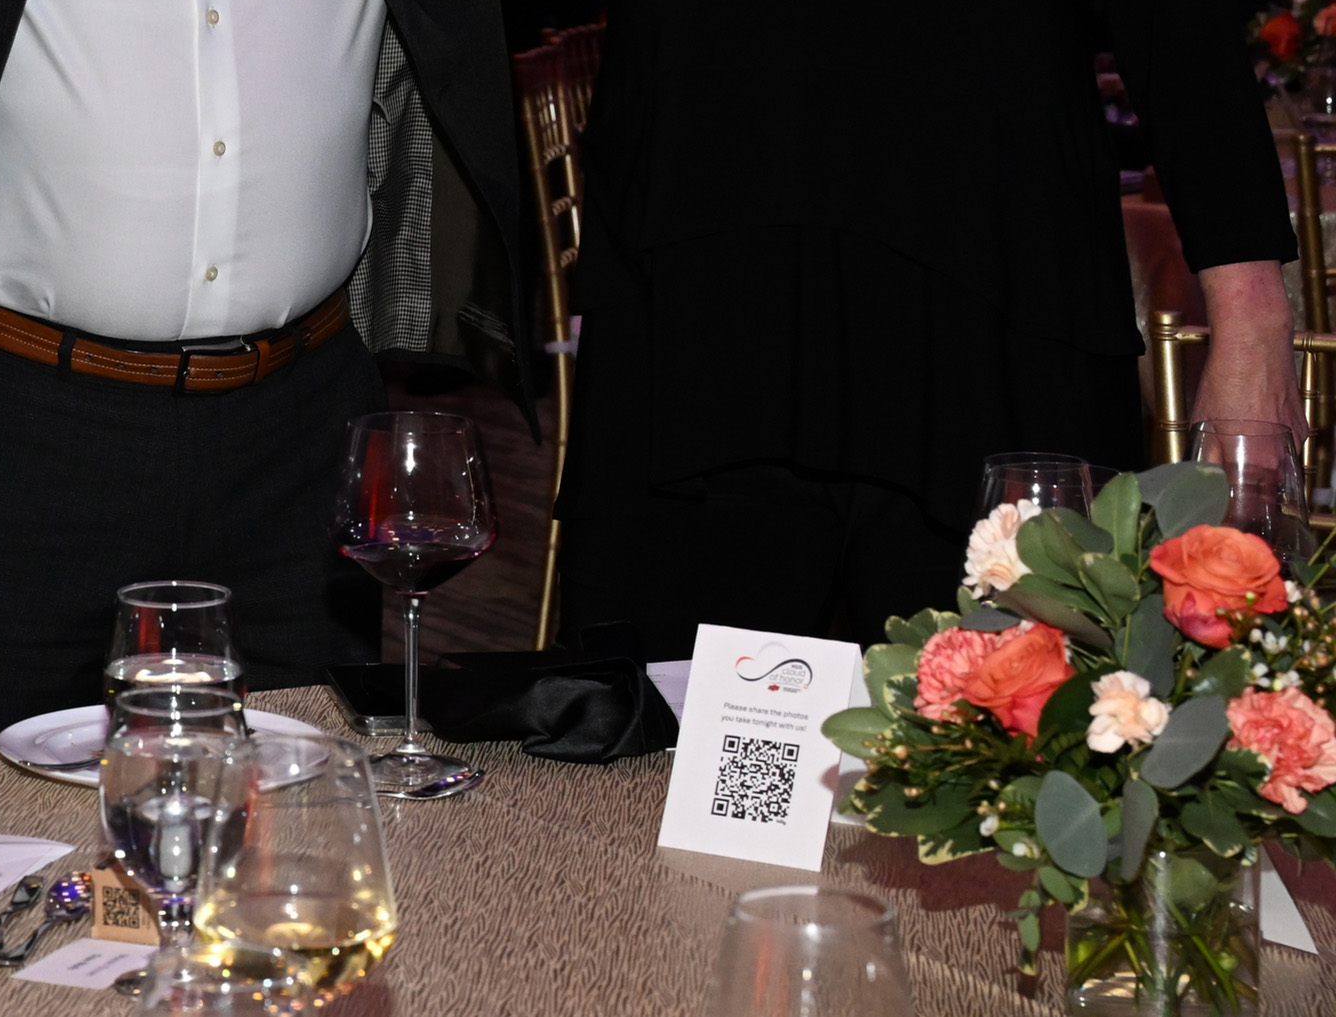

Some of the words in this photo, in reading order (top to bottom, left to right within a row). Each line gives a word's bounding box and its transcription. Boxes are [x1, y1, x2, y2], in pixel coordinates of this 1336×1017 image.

[779, 674, 805, 684] honor
[781, 668, 806, 677] cloud
[723, 702, 748, 712] Please
[748, 705, 769, 714] share
[770, 709, 782, 717] the
[783, 711, 808, 720] photos
[721, 714, 735, 722] you
[735, 715, 751, 725] take
[752, 717, 778, 728] tonight
[778, 721, 794, 730] with
[795, 724, 808, 732] us!
